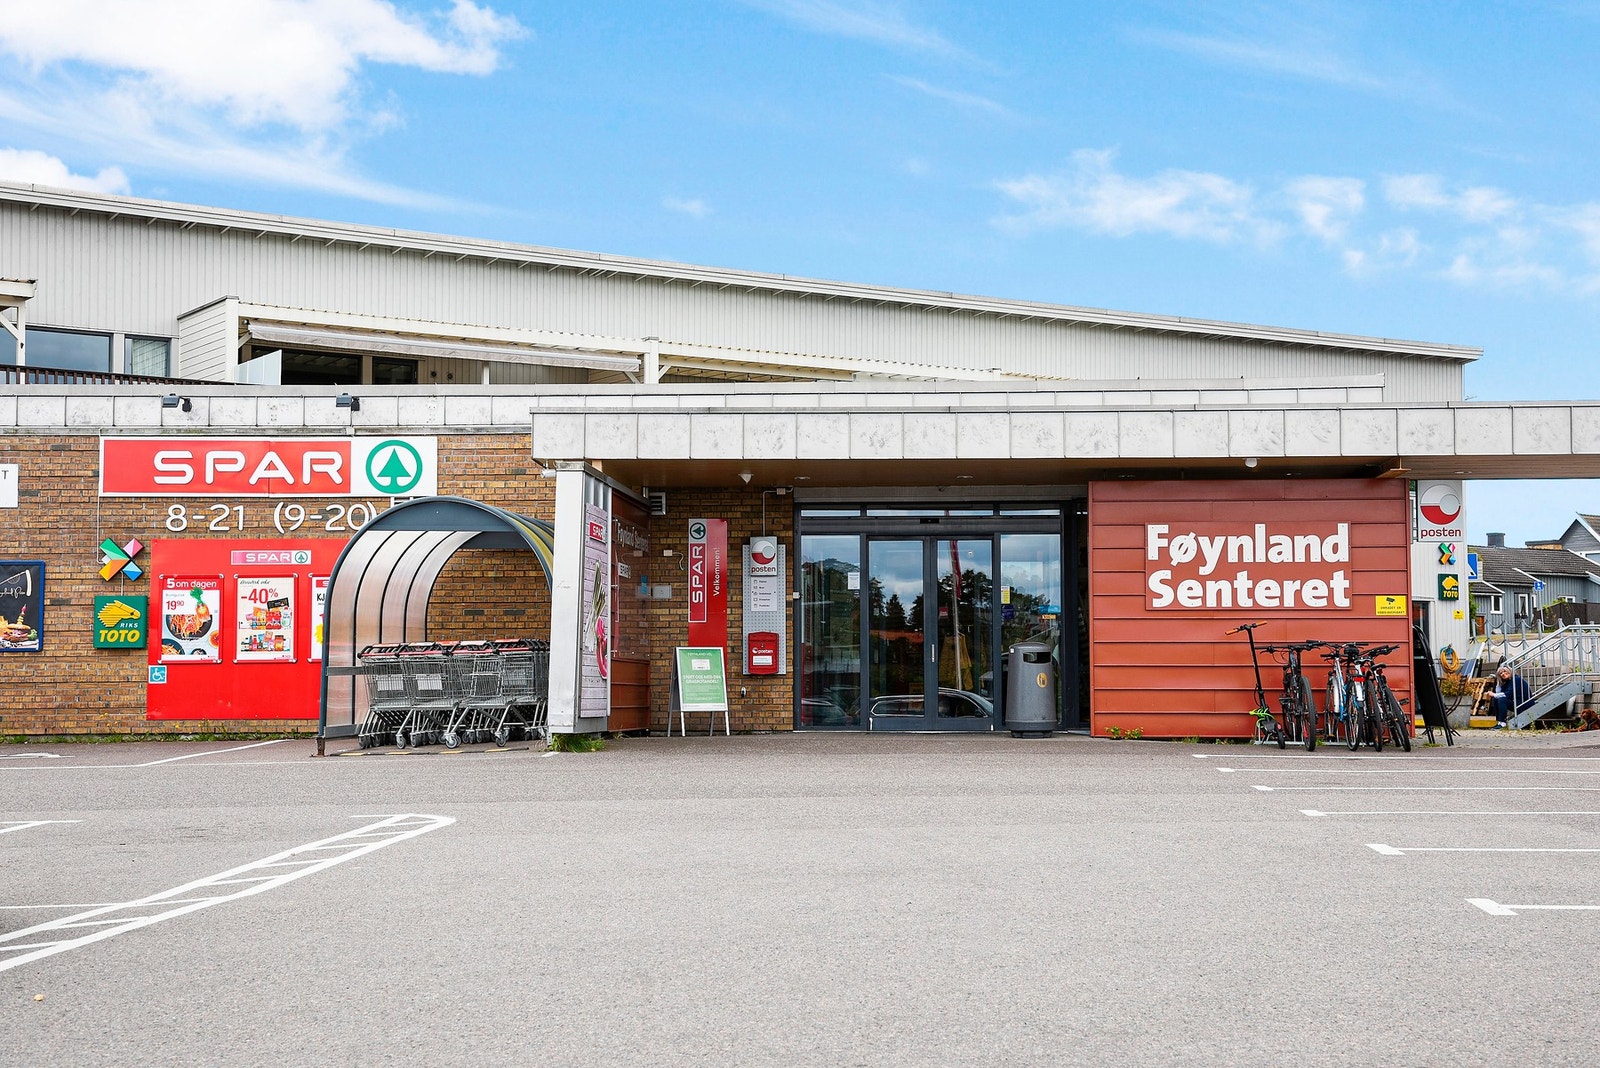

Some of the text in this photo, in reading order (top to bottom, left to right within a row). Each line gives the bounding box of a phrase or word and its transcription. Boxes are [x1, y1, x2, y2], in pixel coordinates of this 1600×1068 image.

[153, 450, 343, 485] SPAR
[165, 501, 377, 534] 8-21 (9-20)
[1420, 526, 1462, 539] posten
[1147, 523, 1349, 576] Føynland
[245, 553, 291, 563] SPAR
[692, 545, 703, 604] SPAR
[751, 566, 777, 574] posten
[190, 580, 217, 589] dagen
[1148, 569, 1350, 608] Senteret
[241, 588, 279, 604] -40%
[99, 629, 141, 643] TOTO
